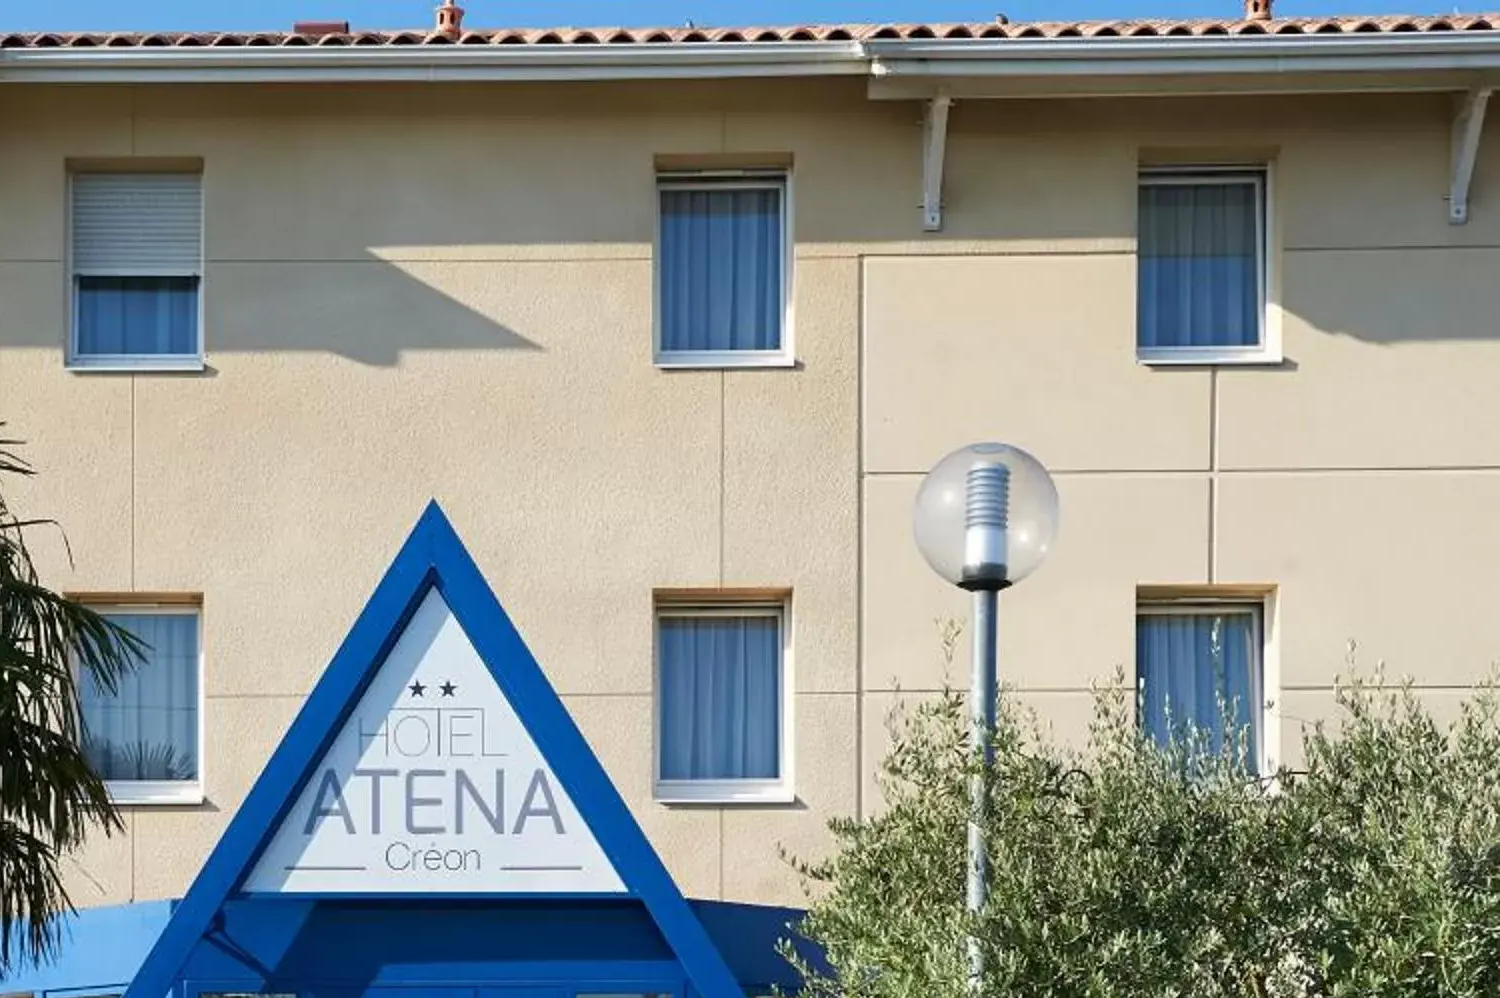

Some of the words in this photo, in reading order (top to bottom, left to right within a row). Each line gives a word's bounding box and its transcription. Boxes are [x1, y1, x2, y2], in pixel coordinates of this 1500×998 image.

[358, 707, 510, 757] HOTEL
[302, 768, 566, 835] ATENA
[385, 841, 481, 871] Créon
